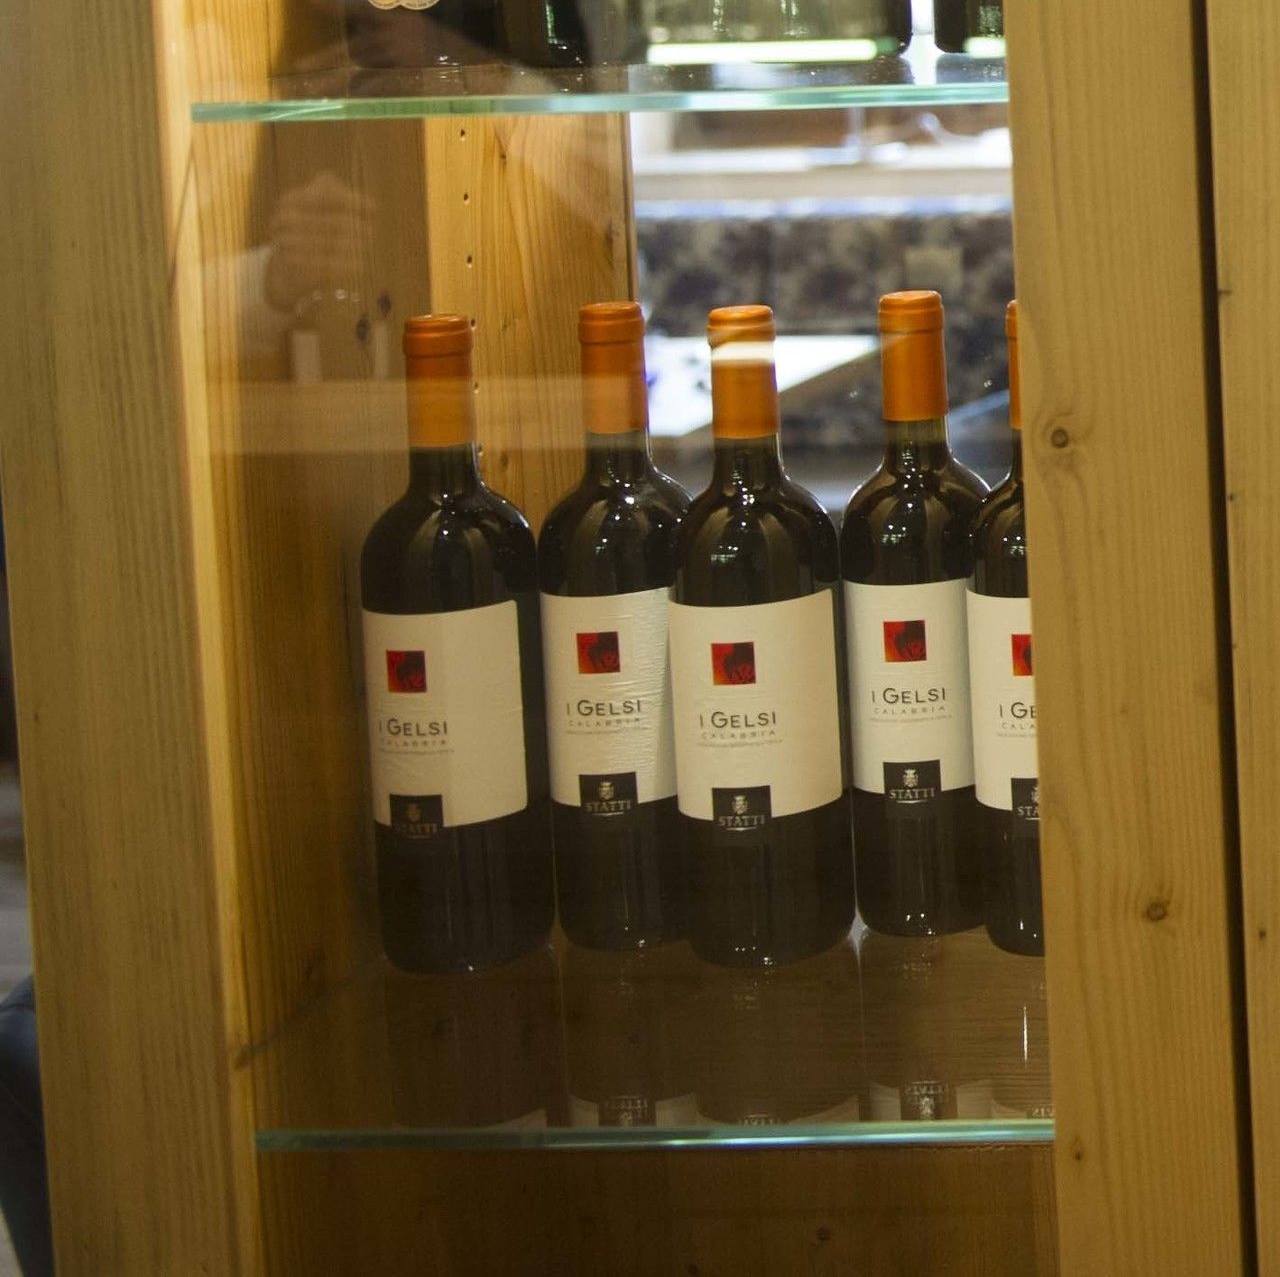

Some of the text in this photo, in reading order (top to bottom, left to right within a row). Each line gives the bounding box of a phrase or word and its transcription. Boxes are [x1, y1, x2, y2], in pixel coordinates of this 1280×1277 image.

[882, 687, 946, 704] GELSI
[577, 699, 642, 716] GELSI
[387, 718, 448, 736] GELSI
[711, 711, 777, 729] GELSI
[889, 787, 935, 800] STATTI
